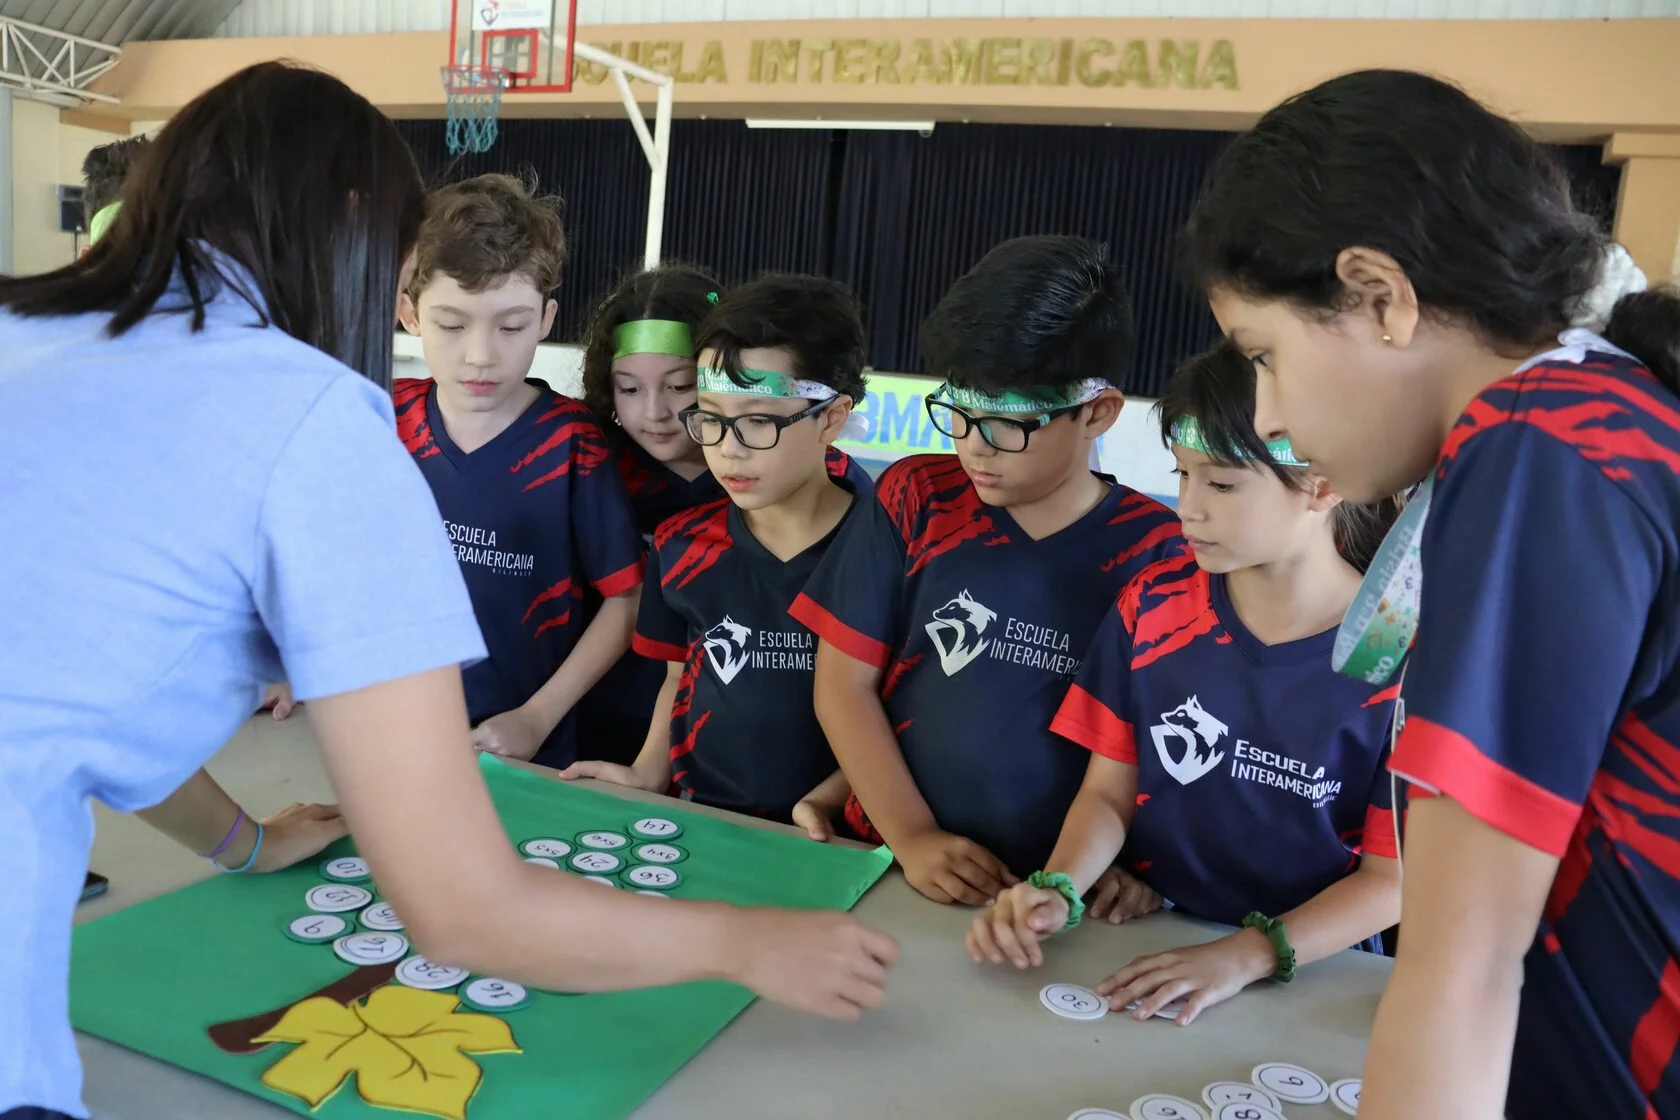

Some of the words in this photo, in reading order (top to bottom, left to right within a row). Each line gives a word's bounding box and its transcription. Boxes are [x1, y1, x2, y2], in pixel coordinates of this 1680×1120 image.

[748, 38, 1239, 91] INTERAMERICANA
[451, 543, 534, 570] ERAMERICANA
[759, 630, 813, 649] ESCUELA
[1005, 617, 1070, 652] ESCUELA
[752, 650, 817, 671] INTERAME
[1234, 738, 1325, 780] ESCUELA
[1231, 759, 1342, 800] INTERAMERICANA
